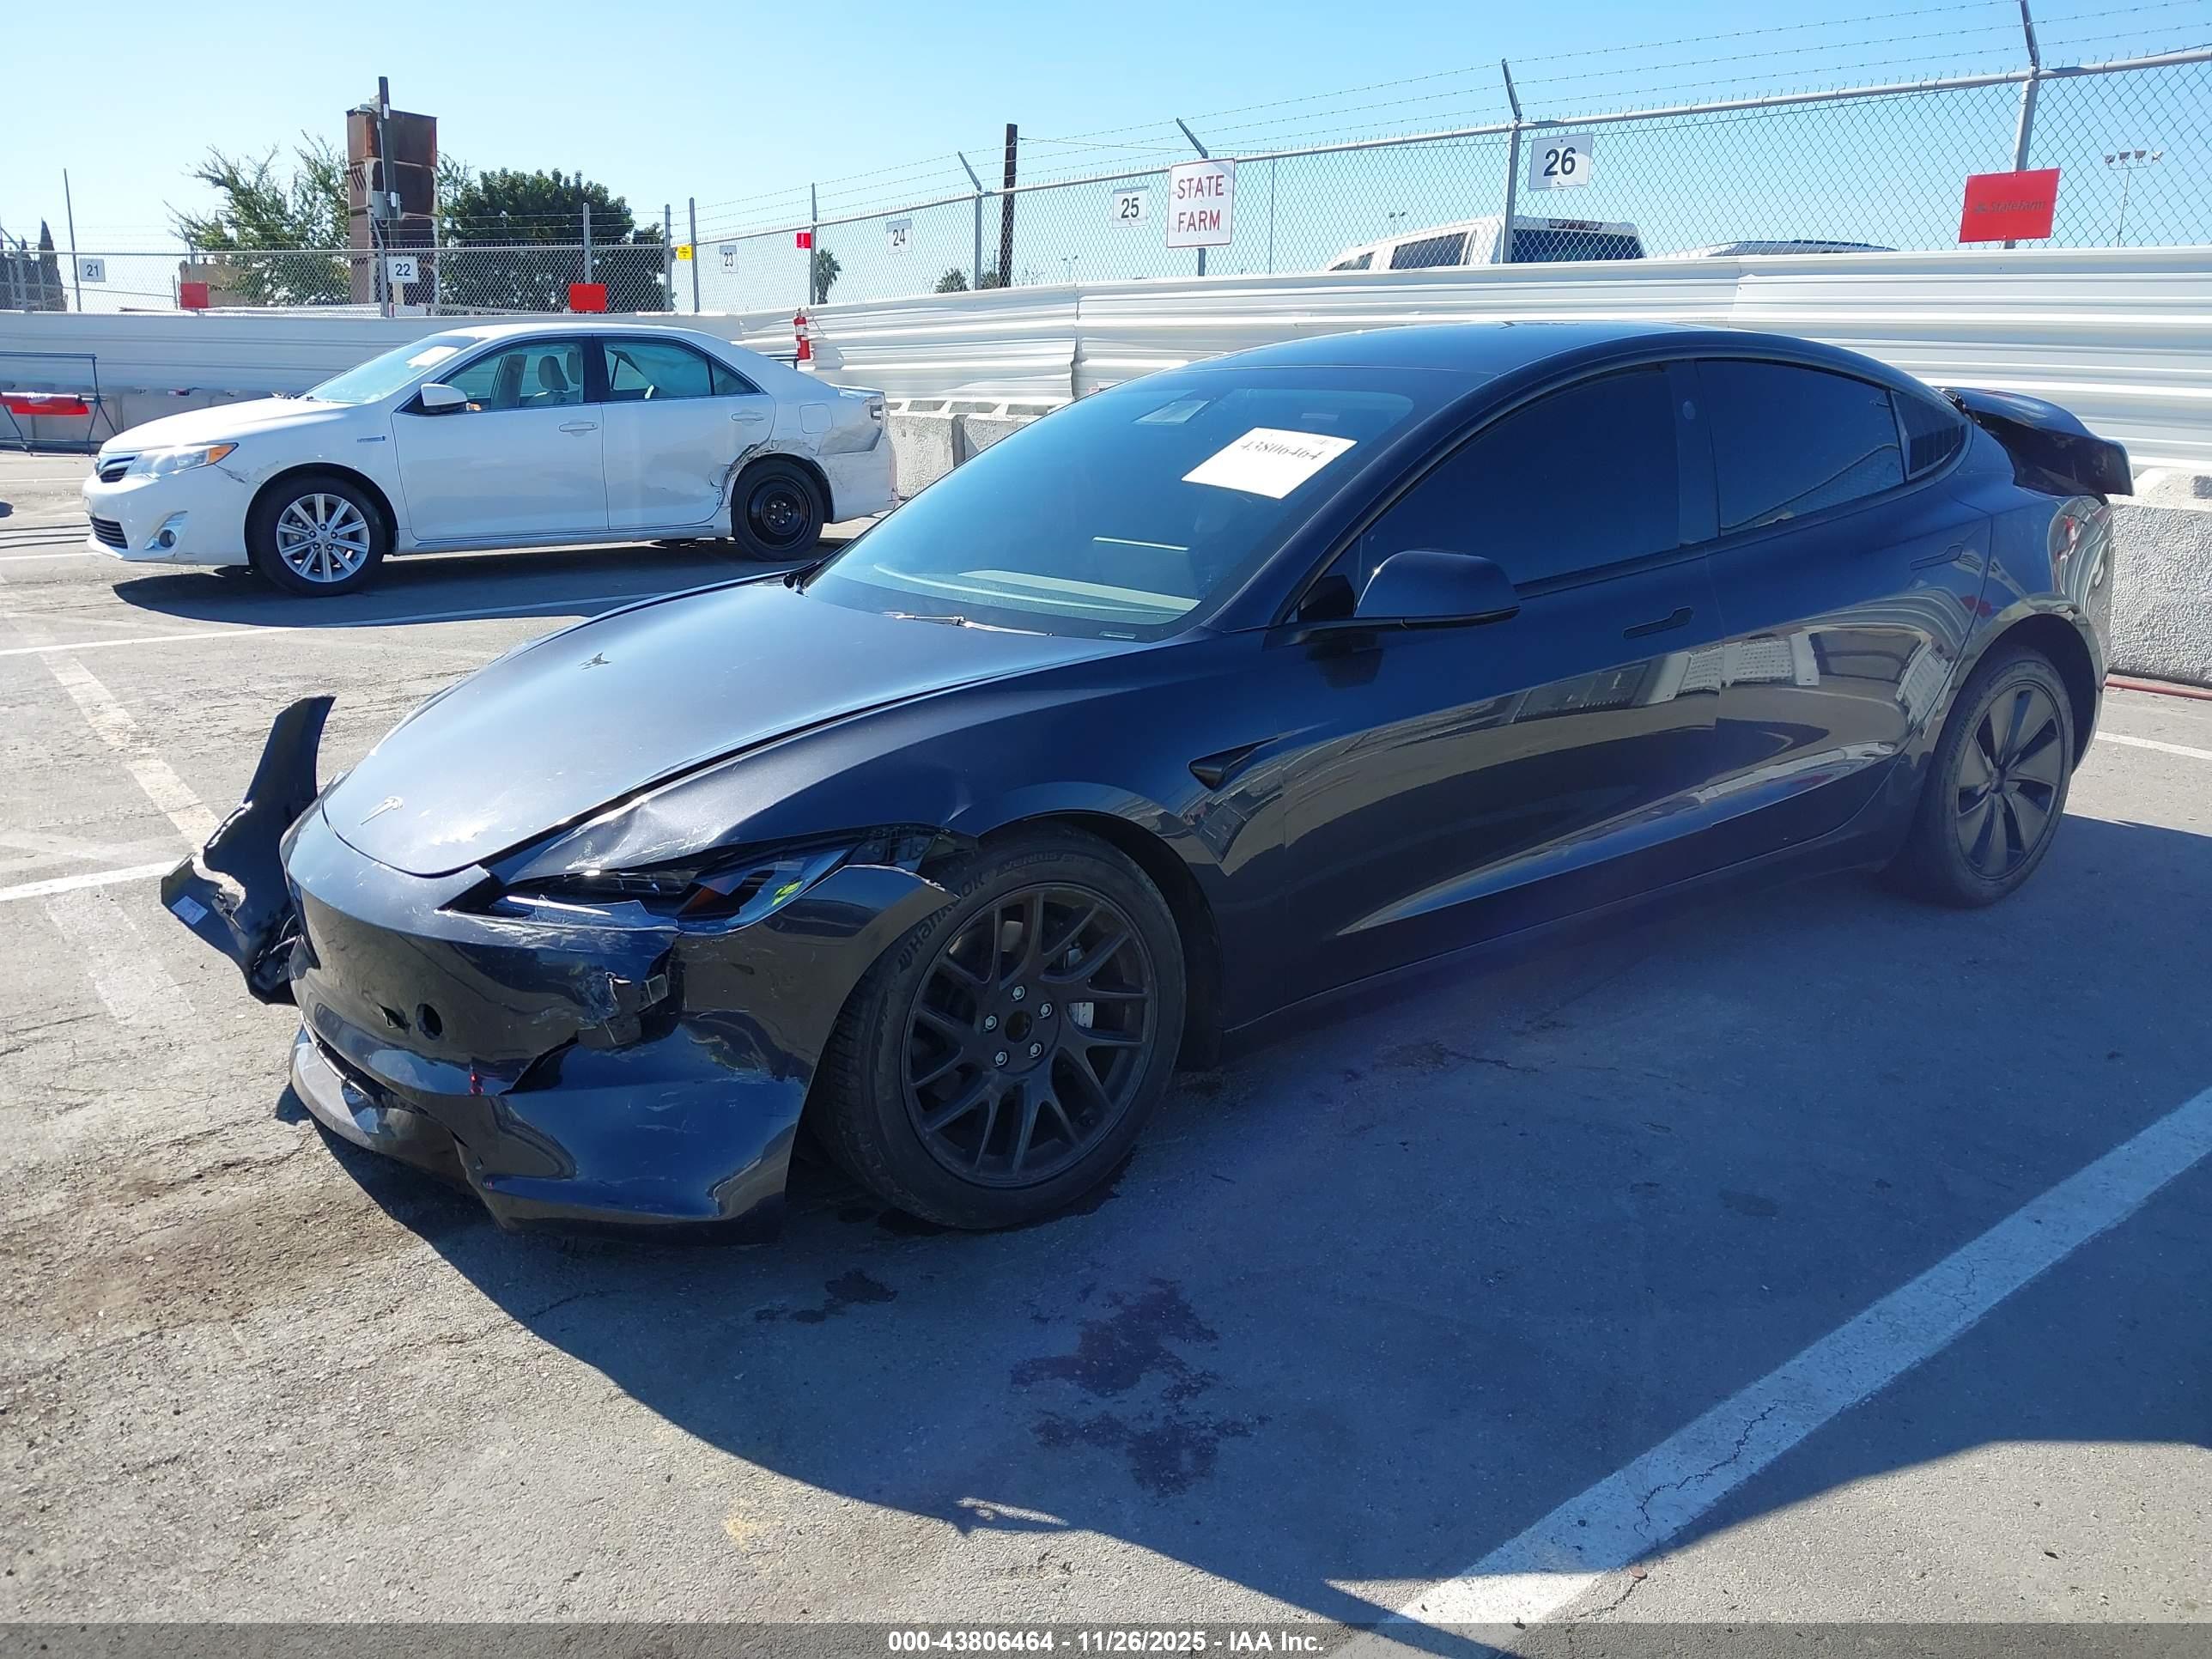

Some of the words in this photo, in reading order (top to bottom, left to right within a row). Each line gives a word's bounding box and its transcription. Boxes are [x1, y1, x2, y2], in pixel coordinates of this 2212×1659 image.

[1543, 146, 1577, 177] 26
[1176, 174, 1224, 200] STATE
[1121, 197, 1139, 219] 25
[1177, 209, 1221, 234] FARM
[892, 228, 906, 247] 24
[724, 252, 734, 267] 23
[86, 264, 99, 276] 21
[395, 263, 411, 276] 22
[1241, 441, 1325, 460] 43806464
